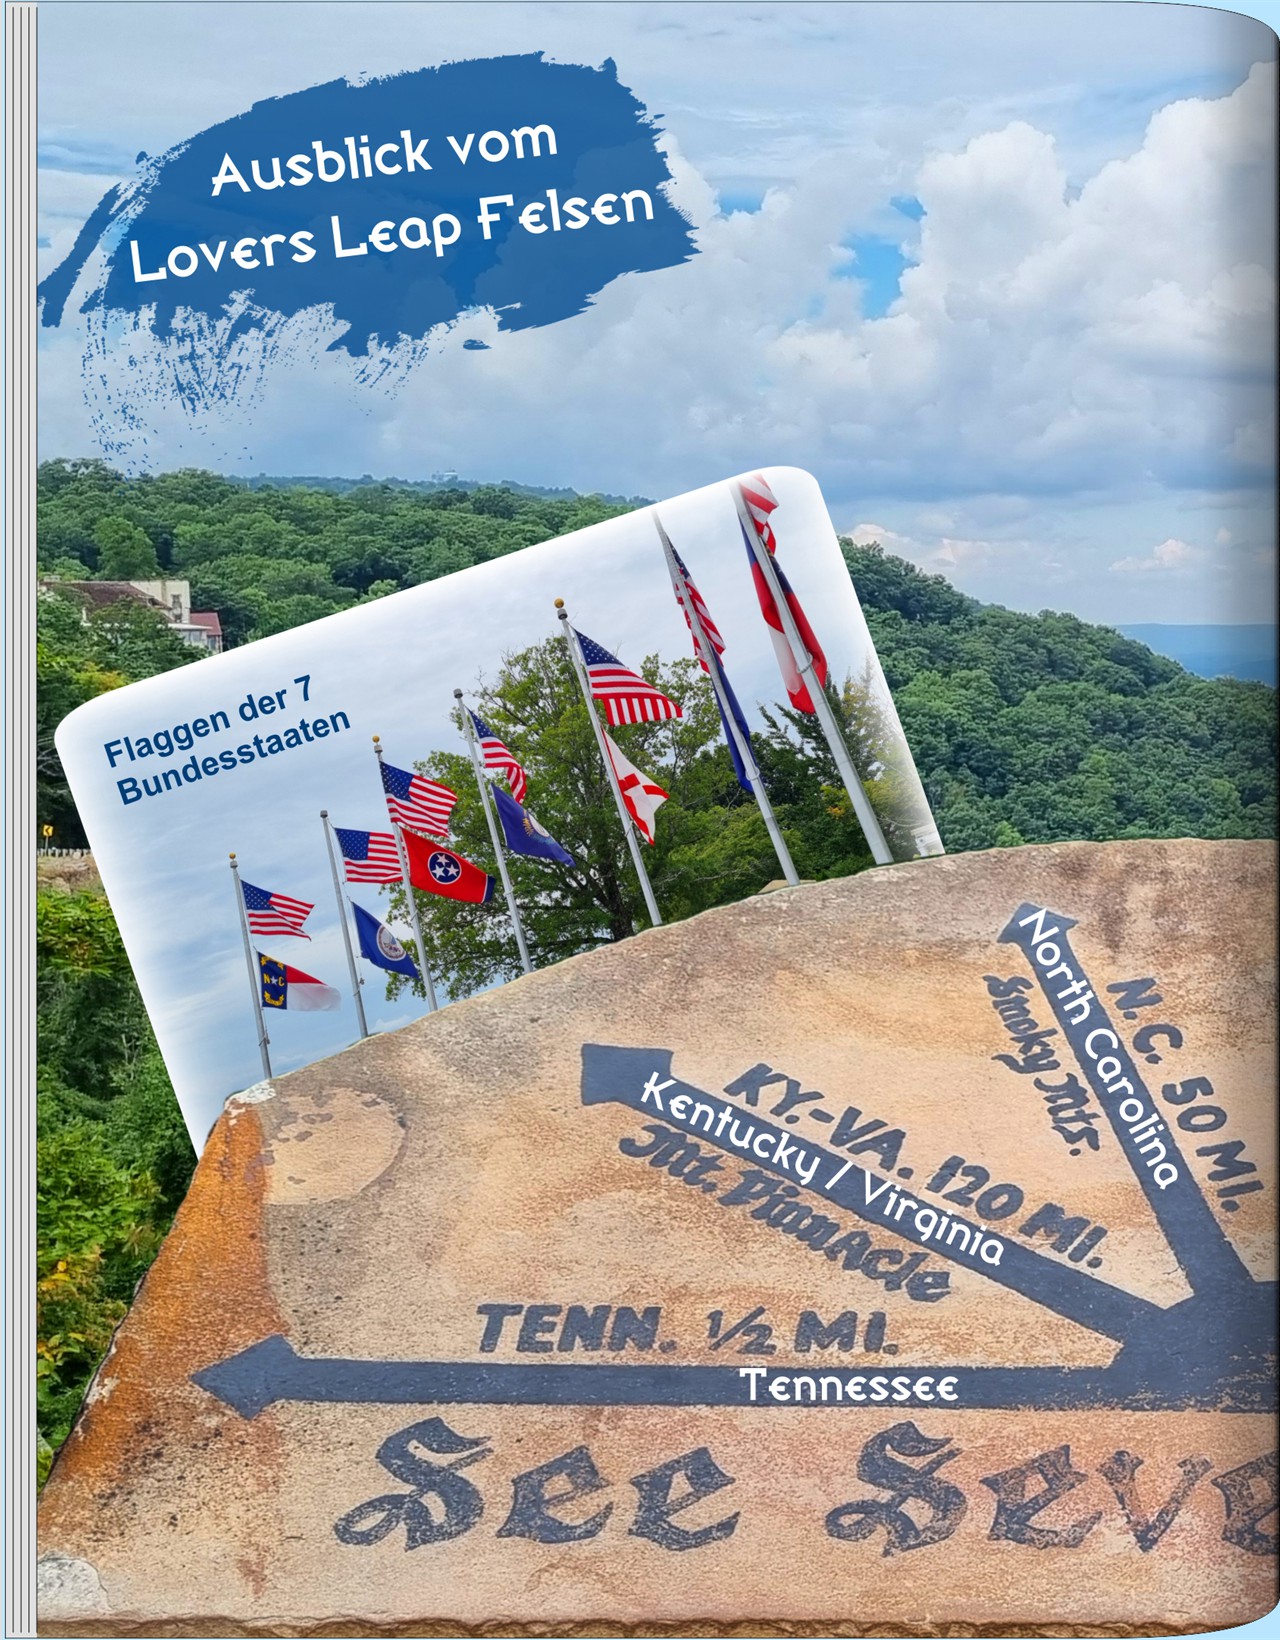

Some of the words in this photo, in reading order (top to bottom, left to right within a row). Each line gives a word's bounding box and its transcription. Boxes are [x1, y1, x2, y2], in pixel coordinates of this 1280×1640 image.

[982, 974, 1062, 1075] Smoky
[1033, 1072, 1102, 1157] Mts.
[618, 1124, 724, 1193] Mt.
[1161, 1076, 1228, 1133] 50
[1195, 1140, 1265, 1213] MI.
[924, 1154, 1024, 1221] 120
[1018, 1201, 1109, 1269] MI.
[476, 1302, 679, 1354] TENN.
[793, 1309, 899, 1356] MI.
[333, 1416, 741, 1552] See
